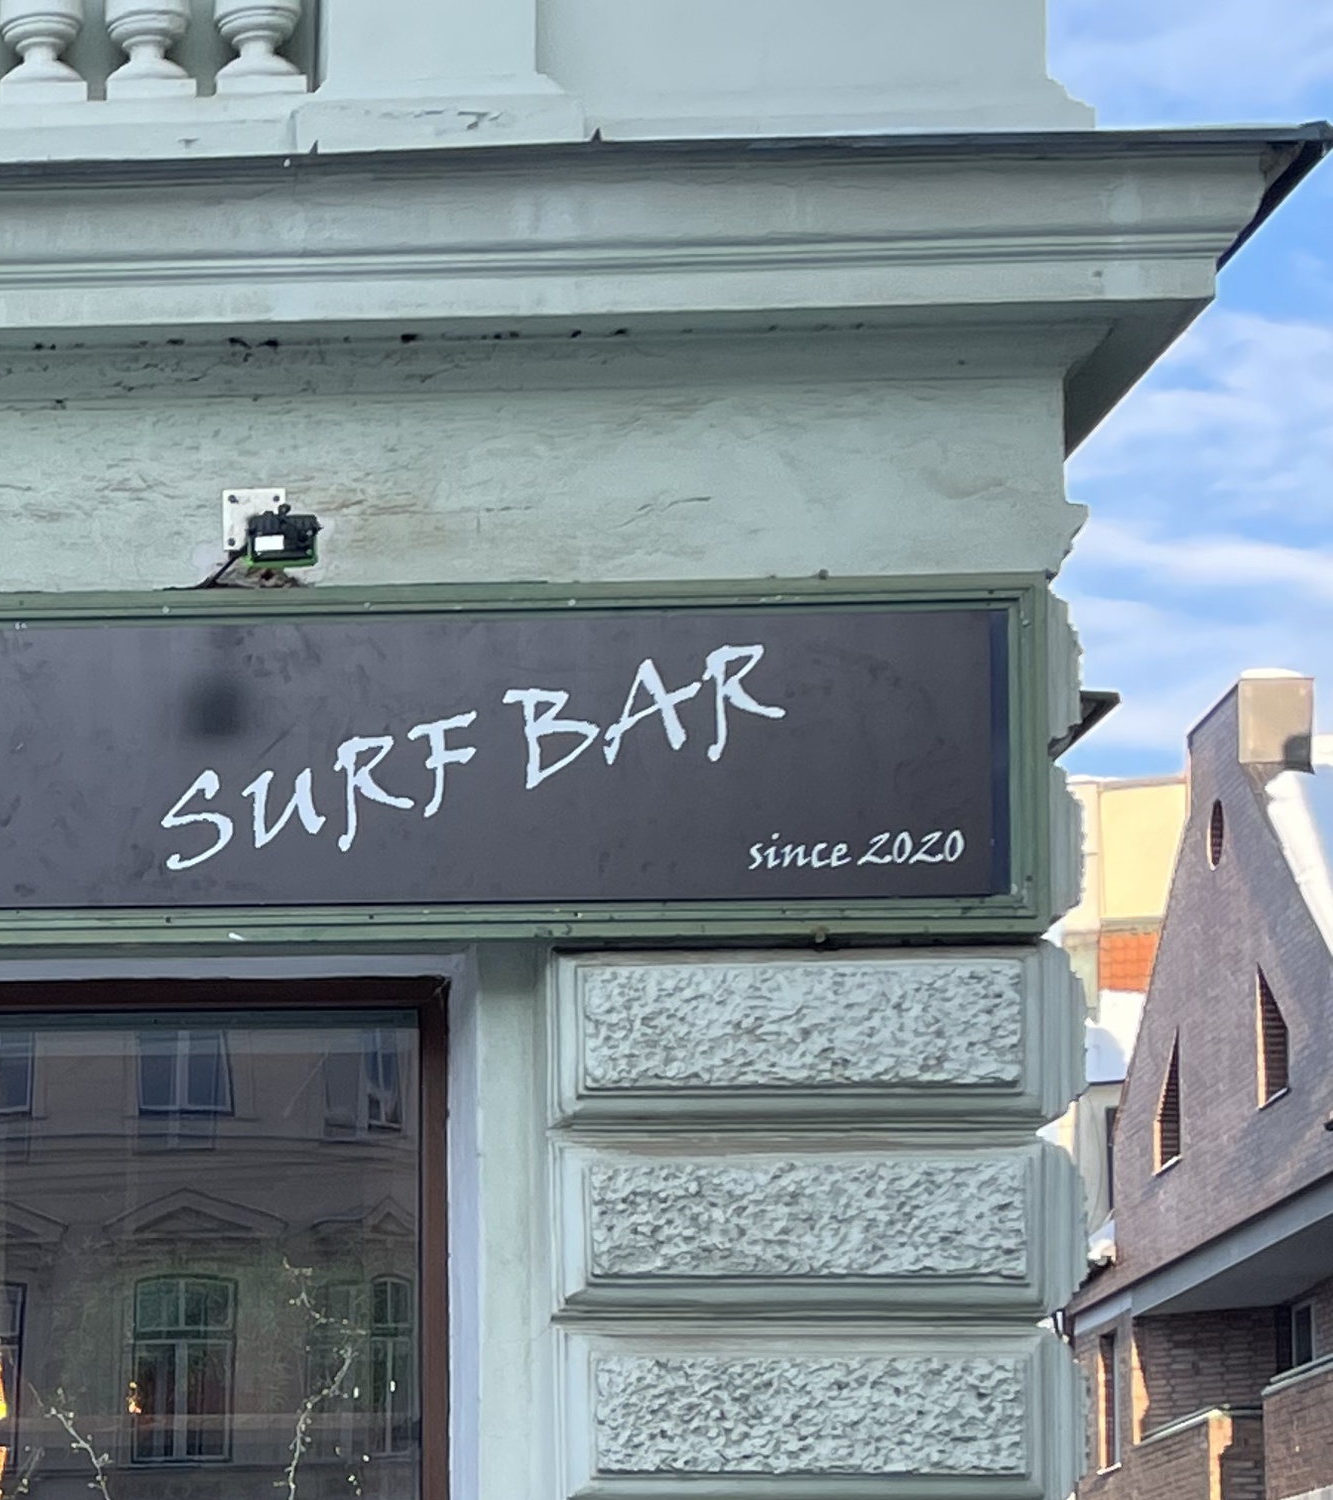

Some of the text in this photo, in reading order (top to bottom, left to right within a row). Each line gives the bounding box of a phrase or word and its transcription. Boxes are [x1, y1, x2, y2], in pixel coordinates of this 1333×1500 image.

[160, 644, 786, 870] SURF BAR
[748, 829, 965, 869] since 2020
